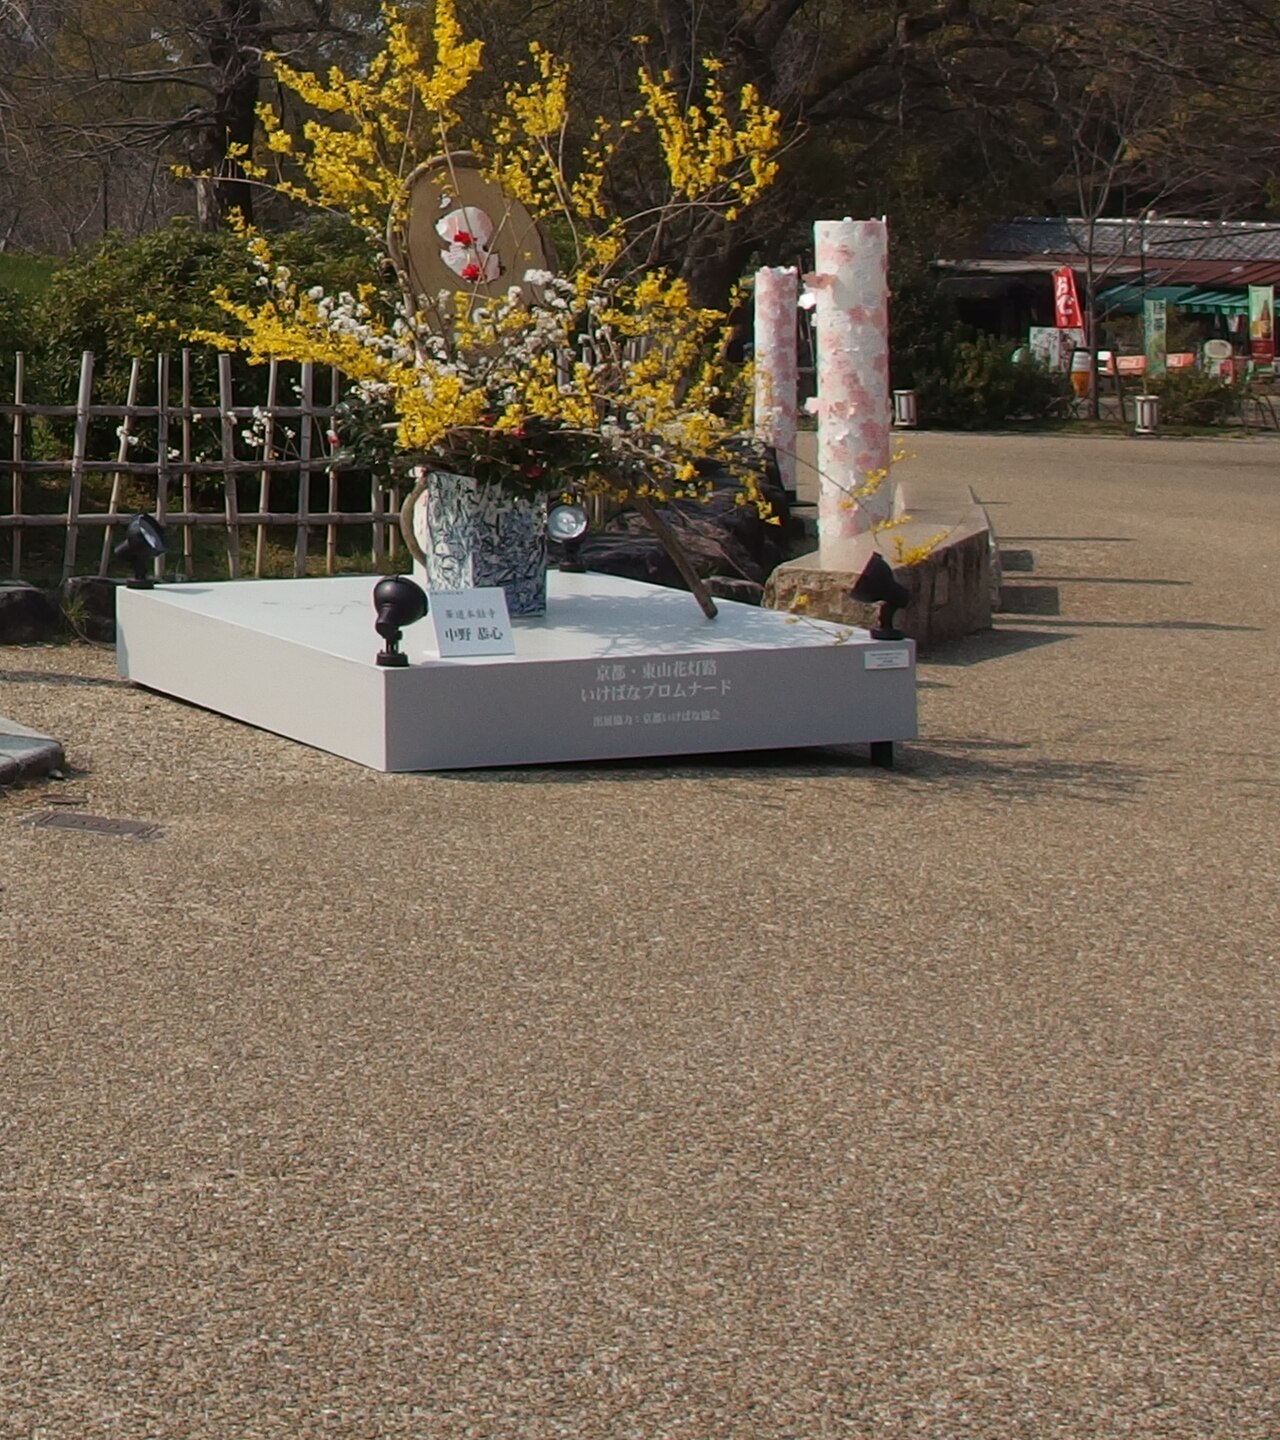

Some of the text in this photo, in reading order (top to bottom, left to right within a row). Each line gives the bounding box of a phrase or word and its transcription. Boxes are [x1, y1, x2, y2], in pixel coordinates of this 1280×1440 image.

[445, 627, 471, 642] 中野
[596, 658, 718, 681] 京都・東山花灯路
[581, 679, 733, 702] いけばなプロムナード
